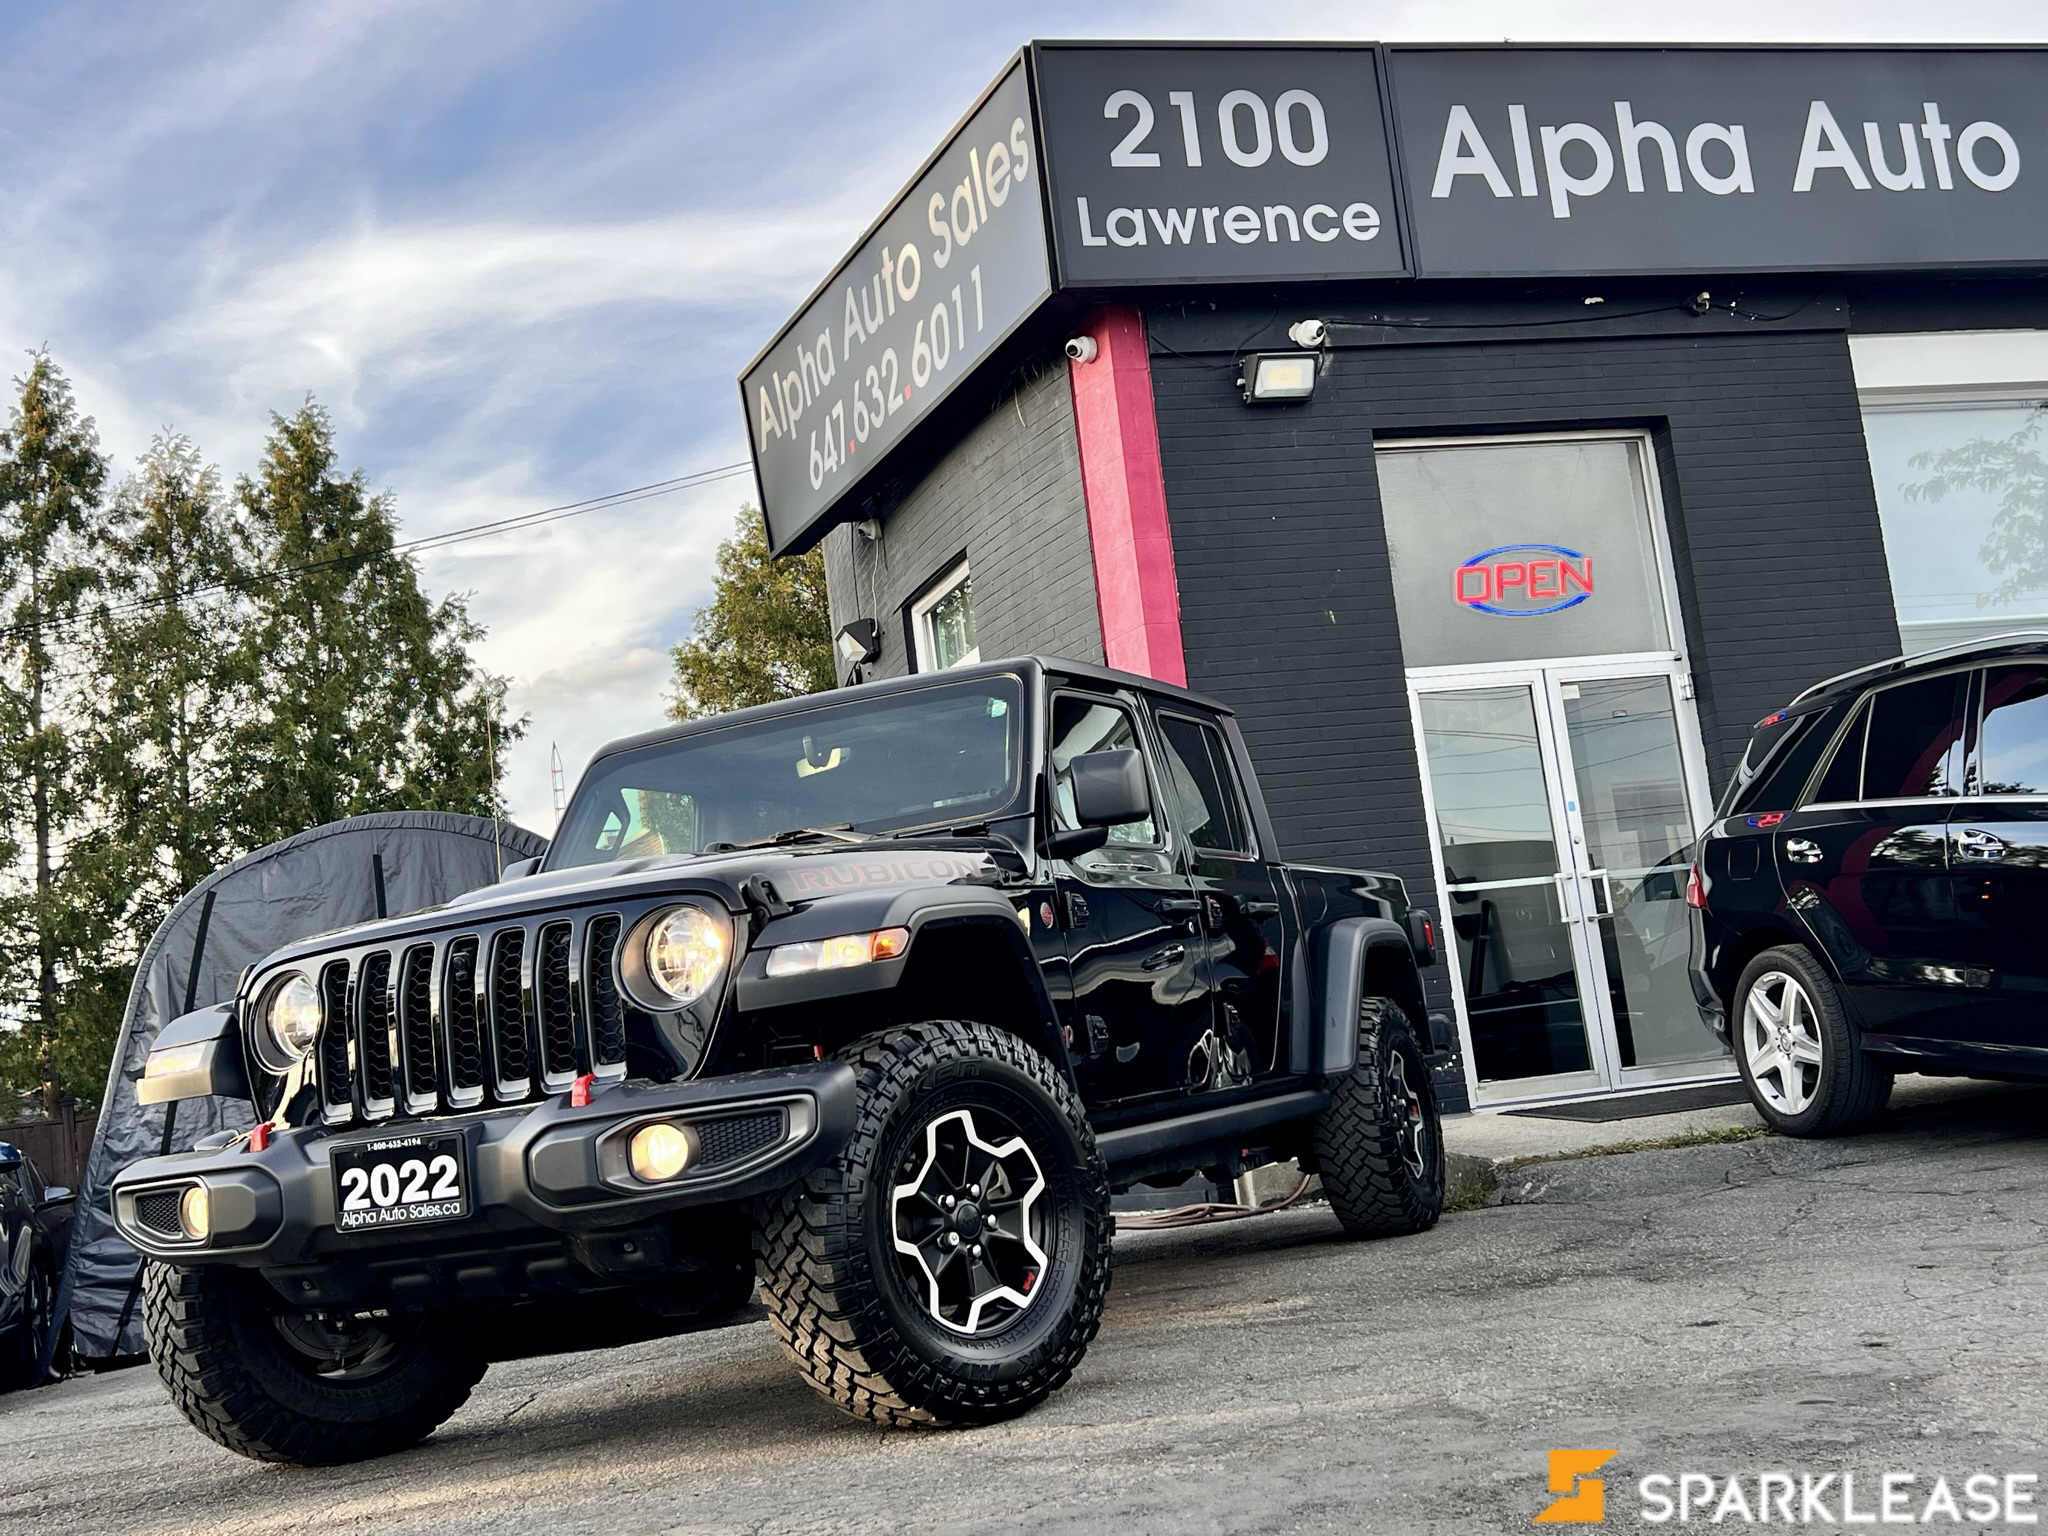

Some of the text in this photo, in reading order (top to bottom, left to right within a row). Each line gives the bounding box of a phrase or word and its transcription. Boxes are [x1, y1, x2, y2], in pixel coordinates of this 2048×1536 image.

[1103, 89, 1329, 168] 2100
[1431, 100, 2021, 219] Alpha Auto
[1077, 196, 1381, 247] Lawrence
[760, 117, 1030, 453] Alpha Auto Sales
[810, 264, 984, 490] 647.632.6011
[1455, 556, 1594, 604] OPEN
[792, 857, 982, 892] RUBICON
[341, 1154, 460, 1211] 2022
[341, 1202, 460, 1228] Alpha Auto Sales.ca
